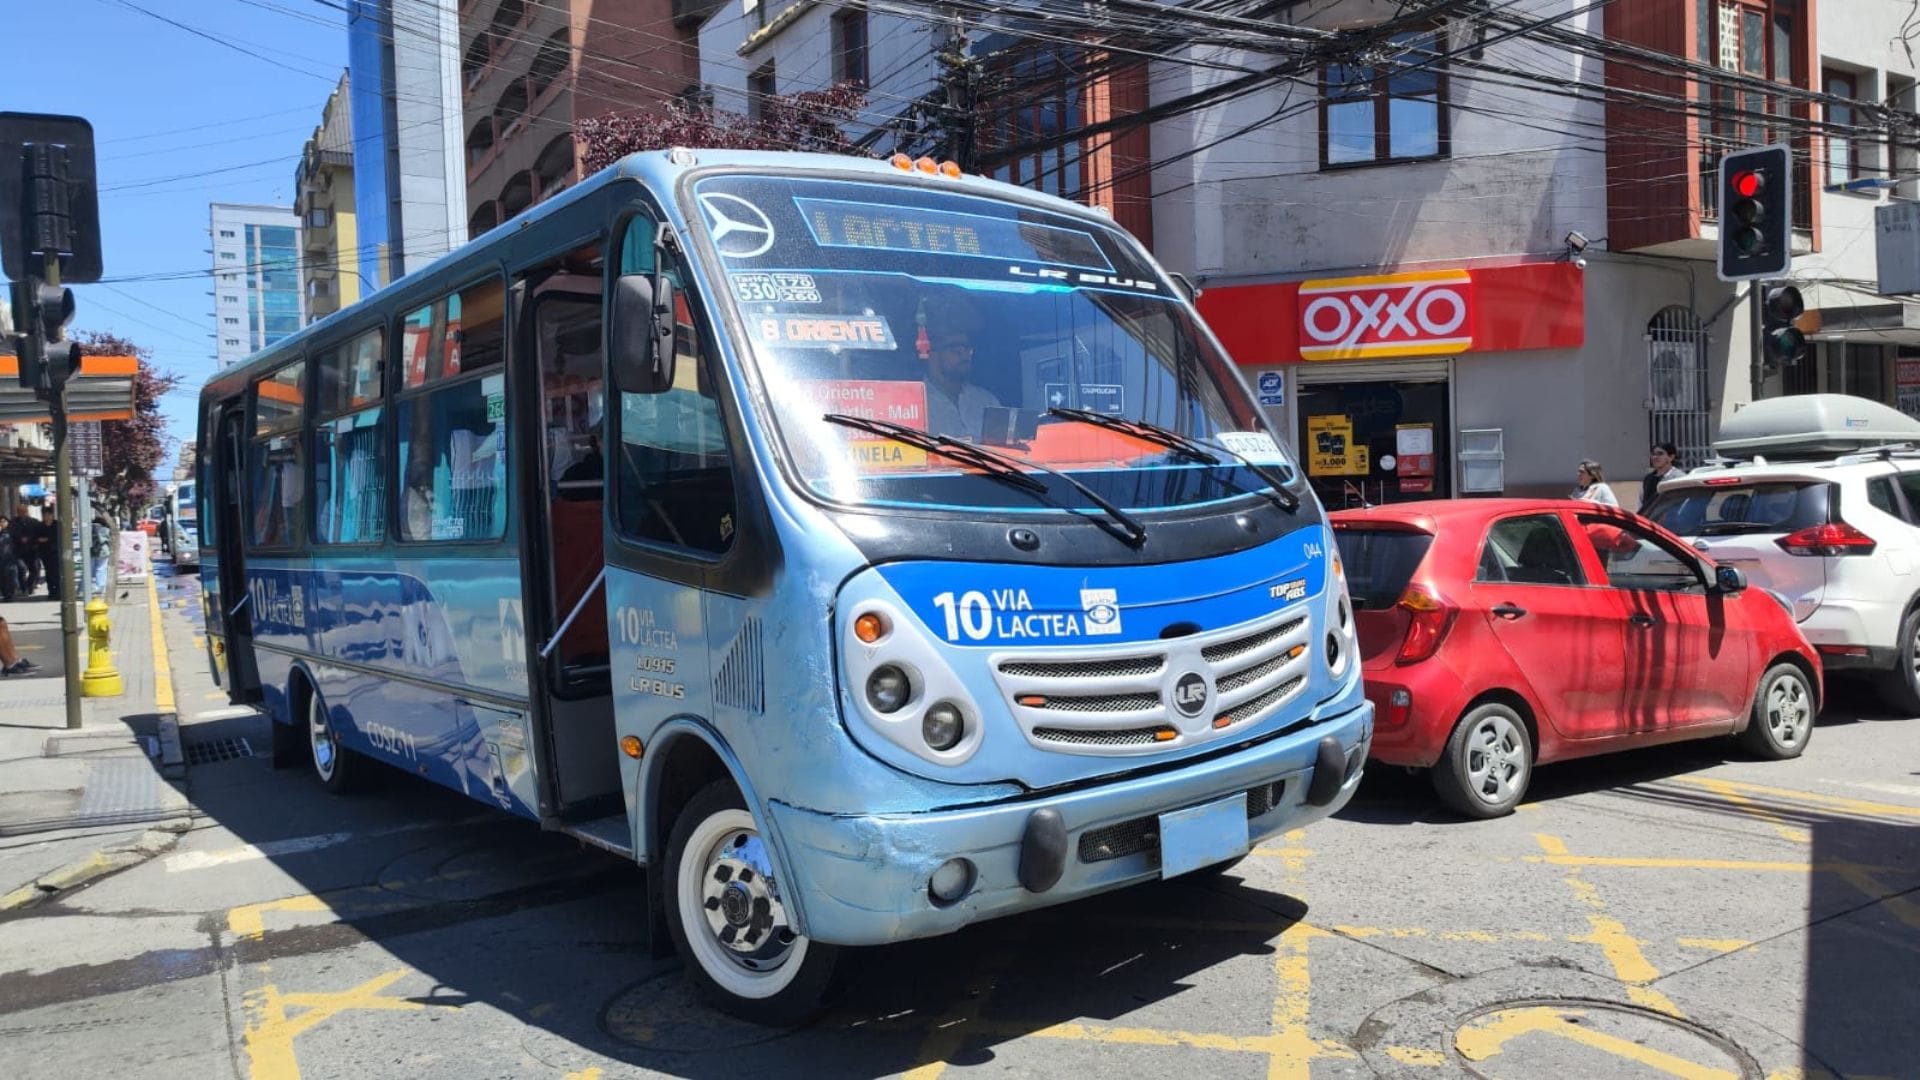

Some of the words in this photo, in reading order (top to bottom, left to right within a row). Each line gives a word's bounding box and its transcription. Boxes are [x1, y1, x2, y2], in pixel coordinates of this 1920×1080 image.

[738, 282, 776, 300] 530
[1304, 286, 1467, 344] OXXO
[786, 319, 887, 342] ORIENTE
[819, 383, 875, 400] Oriente
[888, 405, 919, 421] Mall
[848, 447, 904, 463] INELA
[993, 589, 1033, 611] VIA
[1270, 583, 1290, 598] TOP
[616, 606, 640, 645] 10
[639, 608, 655, 626] VIA
[933, 590, 992, 641] 10
[998, 614, 1080, 639] LACTEA
[641, 629, 678, 650] LACTEA
